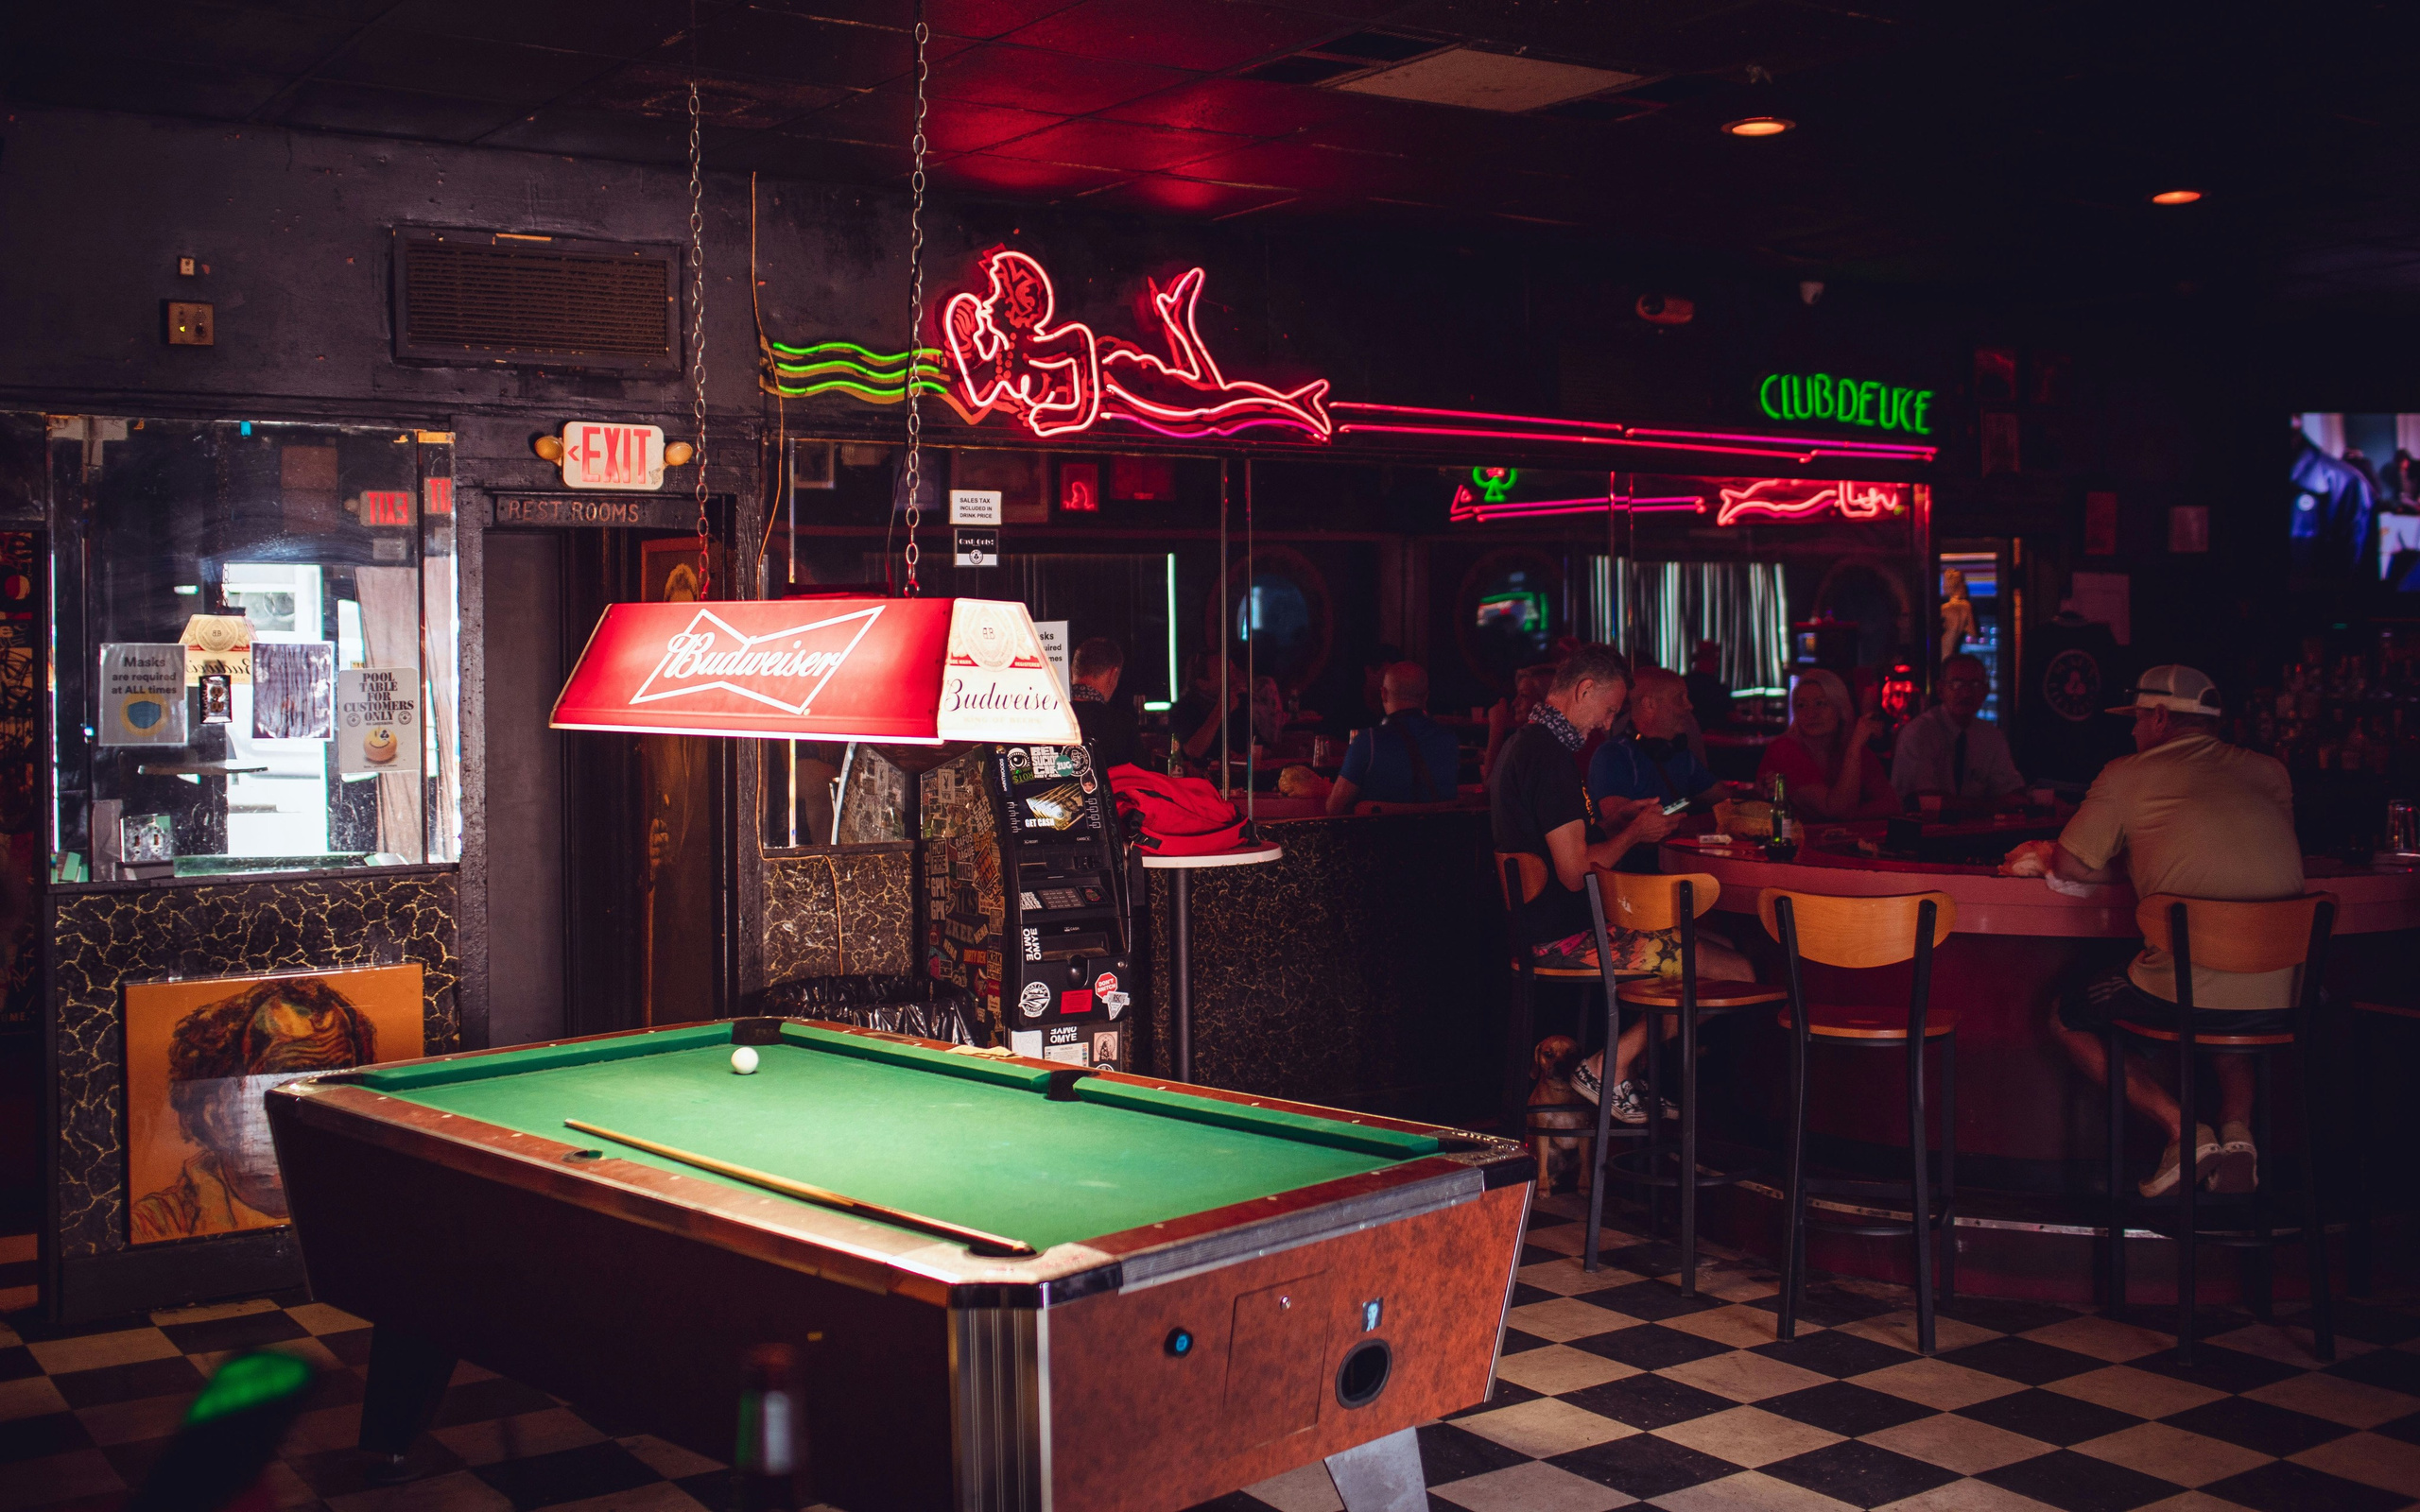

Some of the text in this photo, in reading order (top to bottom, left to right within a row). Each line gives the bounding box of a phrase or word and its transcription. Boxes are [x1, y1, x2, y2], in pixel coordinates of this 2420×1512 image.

[580, 425, 652, 485] EXIT
[508, 500, 640, 524] REST ROOMS
[1039, 631, 1054, 641] sks
[663, 631, 842, 679] Budweiser
[123, 656, 166, 668] Masks
[131, 672, 177, 684] required
[362, 672, 396, 682] POOL
[124, 686, 145, 695] ALL
[148, 686, 178, 695] times
[359, 681, 398, 693] TABLE
[367, 692, 391, 702] FOR
[944, 678, 1060, 713] Budweiser
[343, 700, 415, 713] CUSTOMERS
[364, 711, 395, 722] ONLY
[1030, 746, 1059, 756] BEL
[1025, 818, 1055, 828] GET CASH
[1050, 1033, 1077, 1044] OMYE
